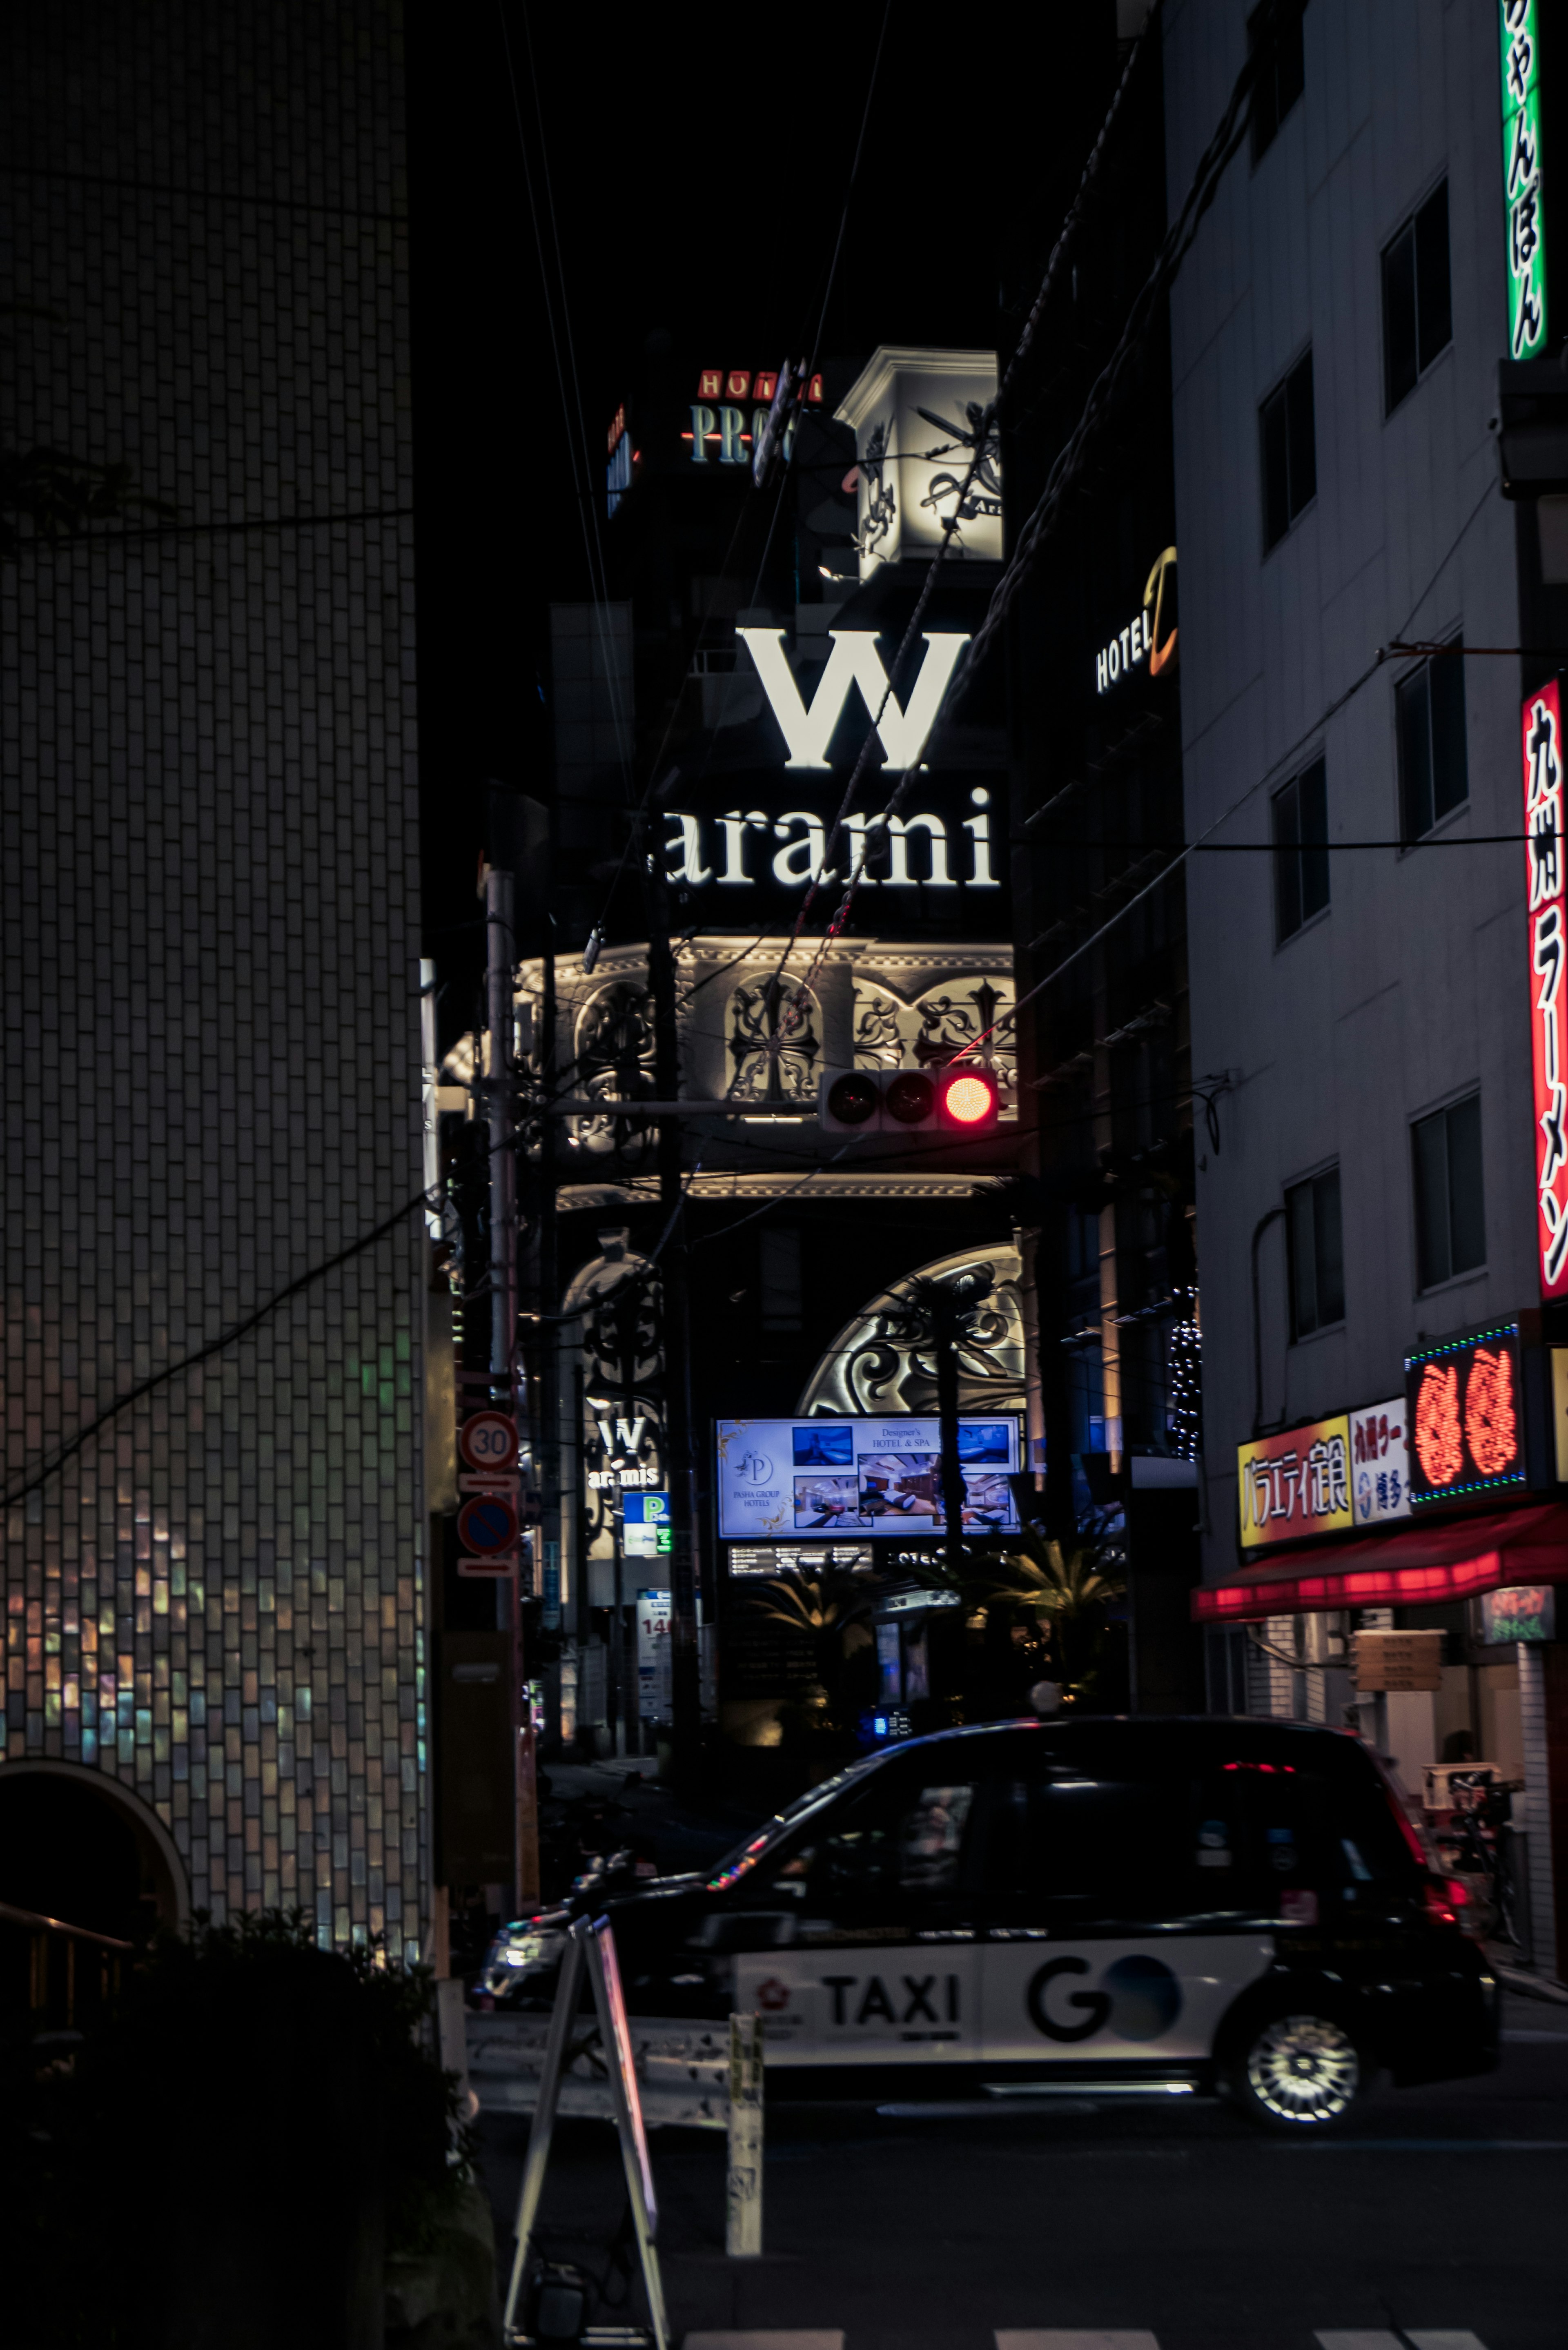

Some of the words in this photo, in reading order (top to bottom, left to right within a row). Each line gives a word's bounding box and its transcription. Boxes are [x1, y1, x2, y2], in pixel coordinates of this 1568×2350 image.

[702, 373, 822, 398] HOTL
[1096, 609, 1153, 695] HOTEL
[735, 628, 971, 772] W
[1526, 698, 1568, 1286] 九州ラーメン
[474, 1429, 506, 1455] 30
[597, 1417, 646, 1455] W
[873, 1439, 902, 1447] HOTEL
[914, 1439, 931, 1447] SPA
[882, 1428, 920, 1438] Designer's
[588, 1463, 659, 1489] armis
[752, 1459, 765, 1481] P
[1243, 1433, 1349, 1530] バラエティ定食
[643, 1496, 666, 1522] P
[822, 1974, 958, 2025] TAXI
